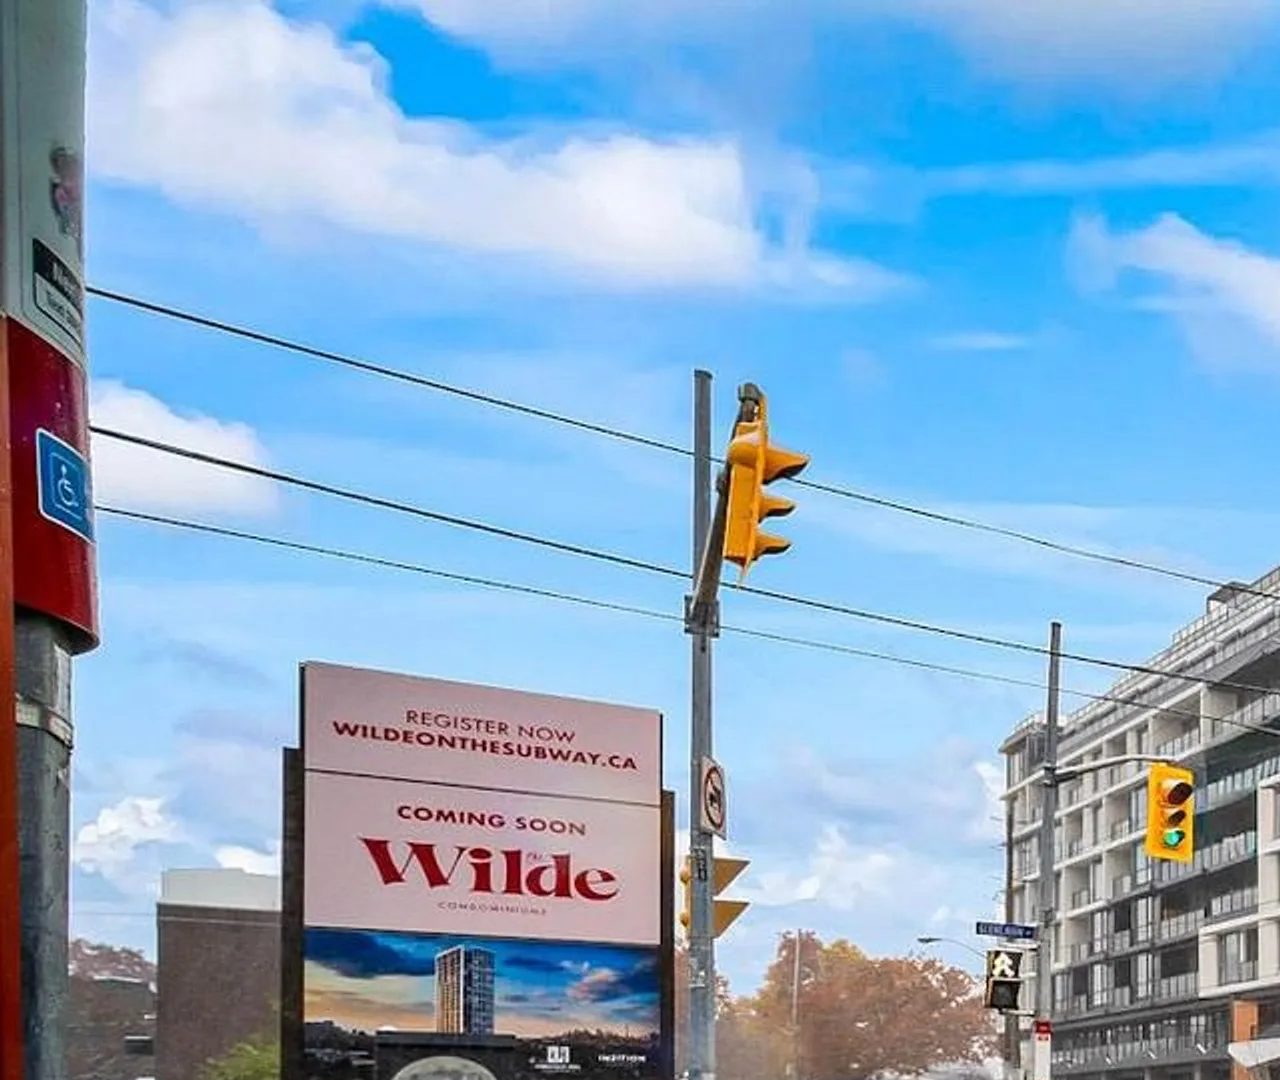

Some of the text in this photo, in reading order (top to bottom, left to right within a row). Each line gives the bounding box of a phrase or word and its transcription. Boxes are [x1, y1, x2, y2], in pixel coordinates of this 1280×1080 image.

[332, 721, 638, 770] WILDEONTHESUBWAY.CA
[405, 710, 576, 744] REGISTER NOW
[397, 805, 586, 836] COMING SOON
[357, 836, 621, 901] Wilde
